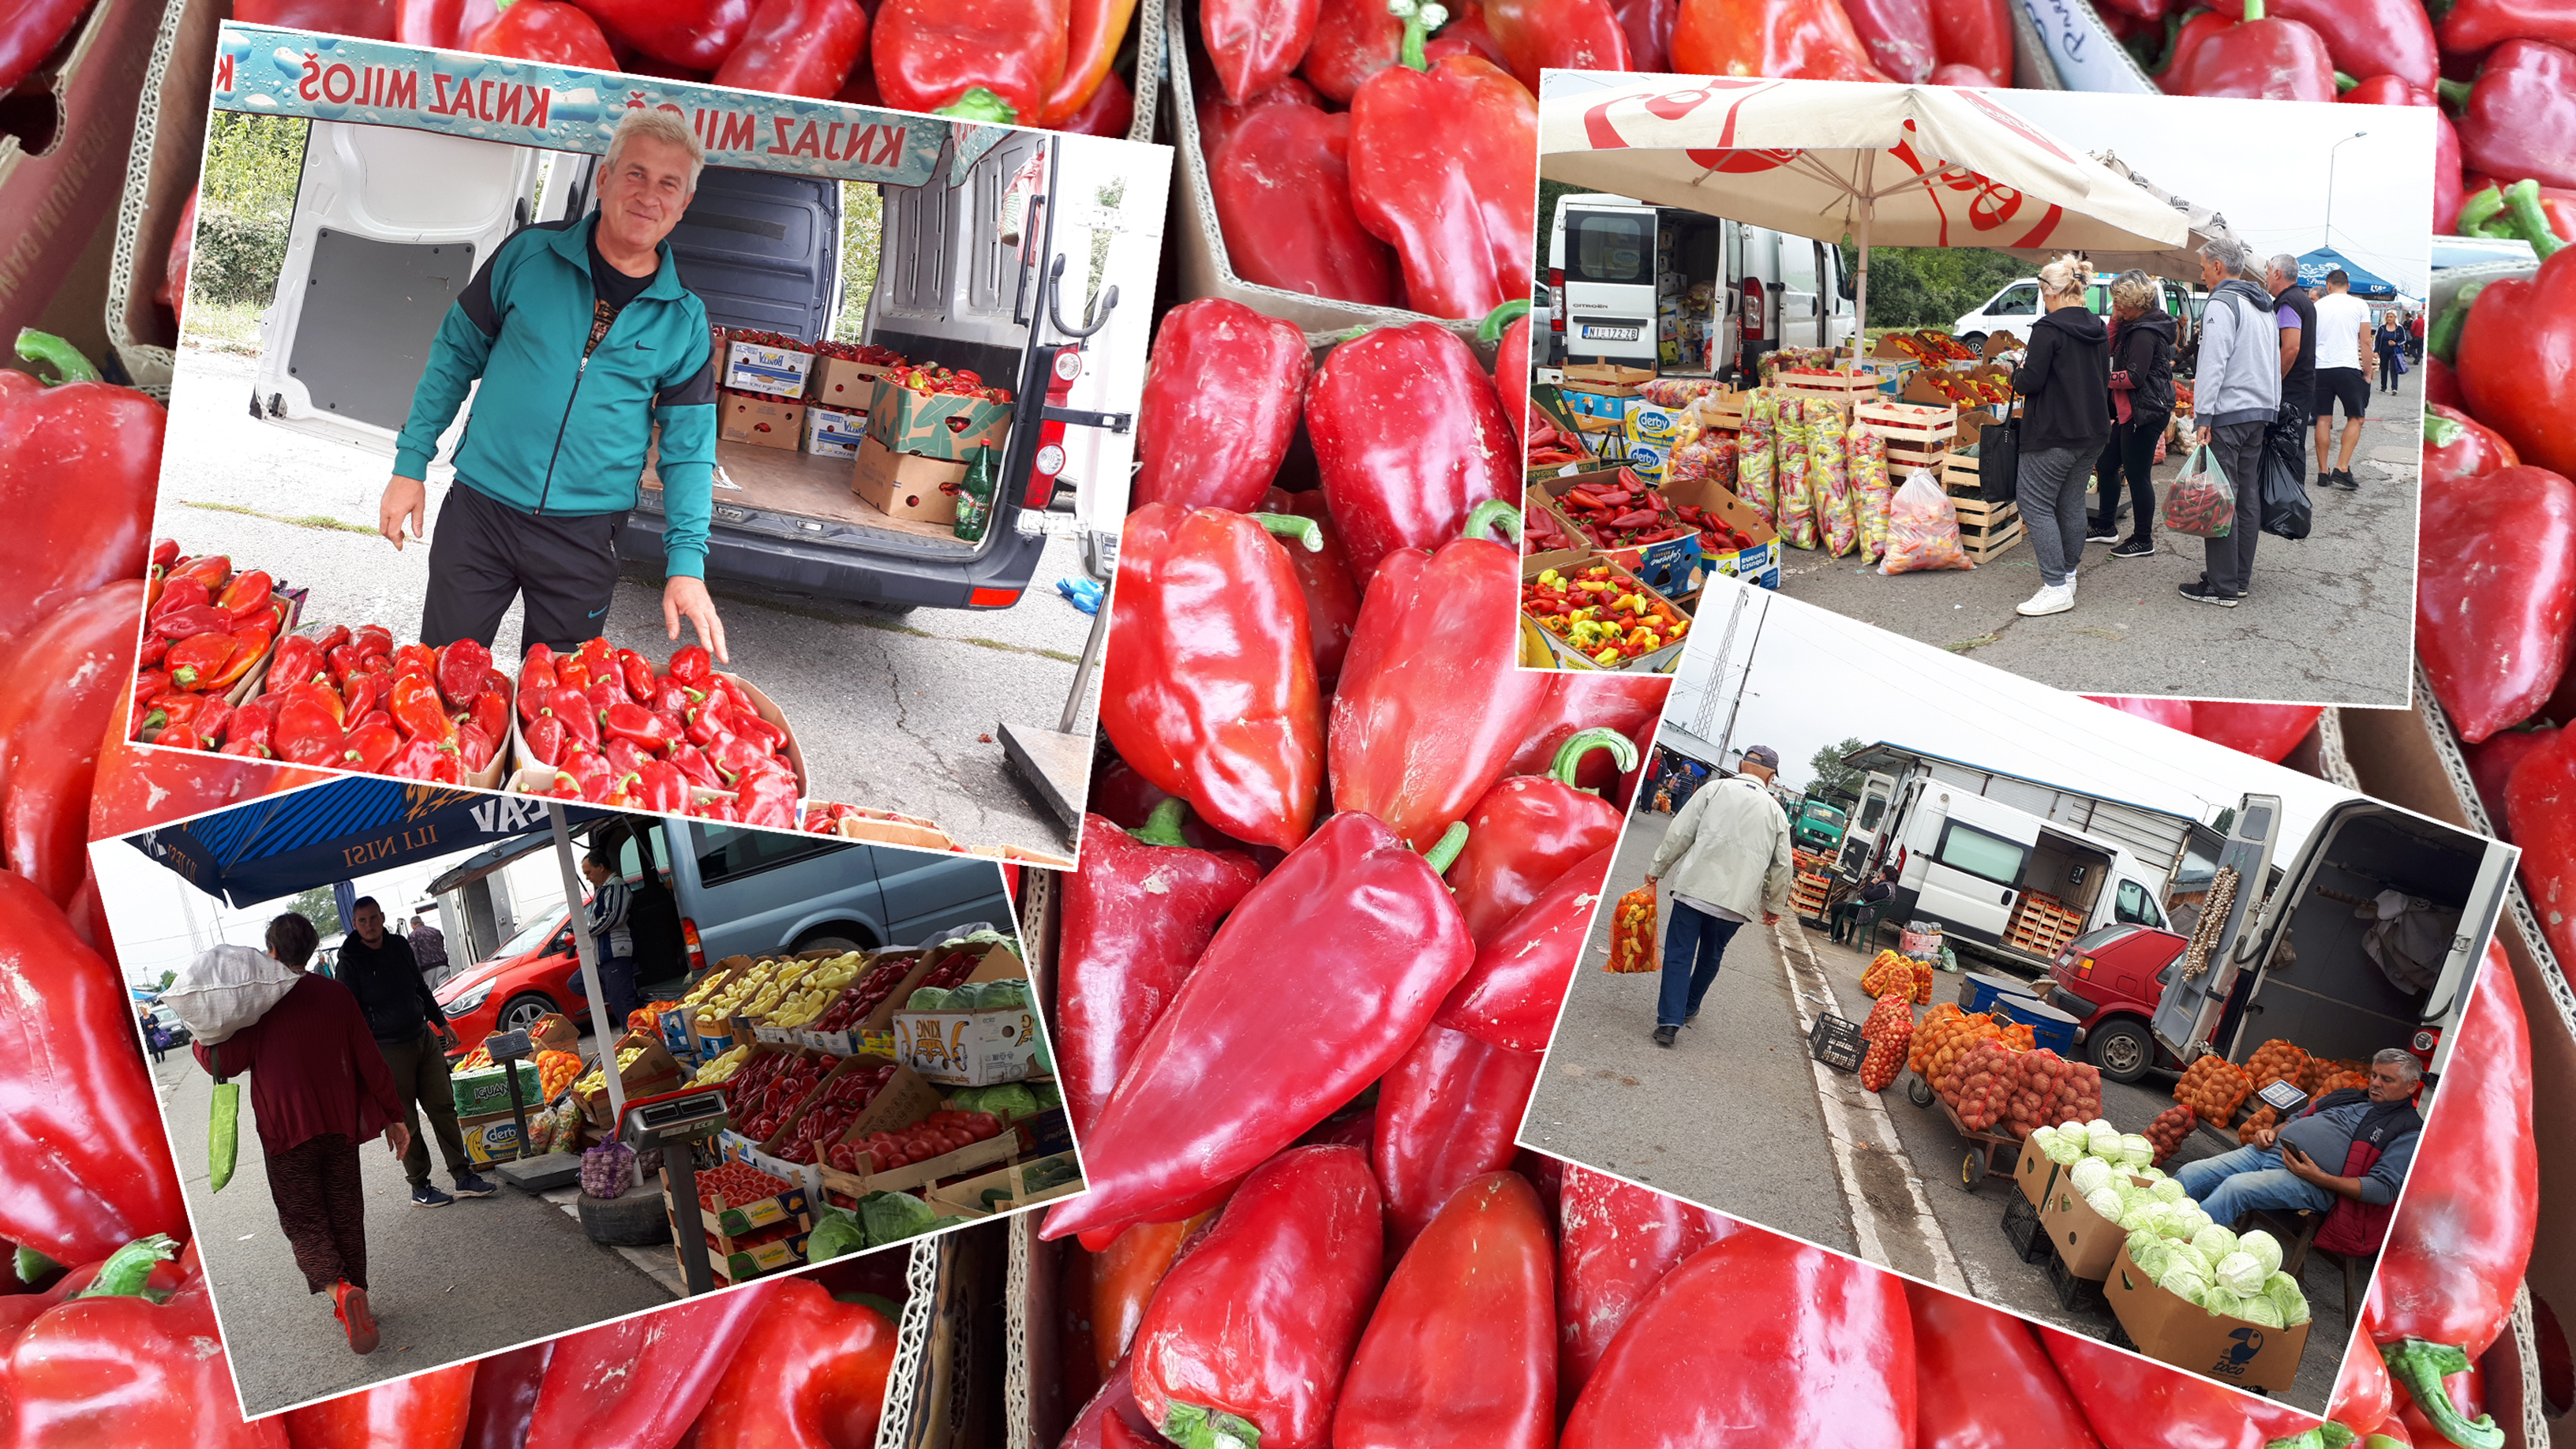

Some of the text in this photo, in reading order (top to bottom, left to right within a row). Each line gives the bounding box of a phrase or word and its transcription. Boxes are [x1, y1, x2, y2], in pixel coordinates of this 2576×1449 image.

[0, 233, 42, 302] BAN
[1608, 328, 1637, 338] 172-ZB
[844, 421, 867, 435] ONITA
[1639, 413, 1668, 429] derby
[1633, 449, 1658, 465] derby
[1527, 469, 1557, 477] ORGANI
[1650, 549, 1681, 566] Supreme
[1741, 551, 1765, 564] banana
[1741, 558, 1765, 571] robusta
[915, 1019, 942, 1039] KING
[474, 1082, 510, 1100] IGUAN
[489, 1125, 518, 1140] derb
[2212, 1360, 2246, 1376] toco
